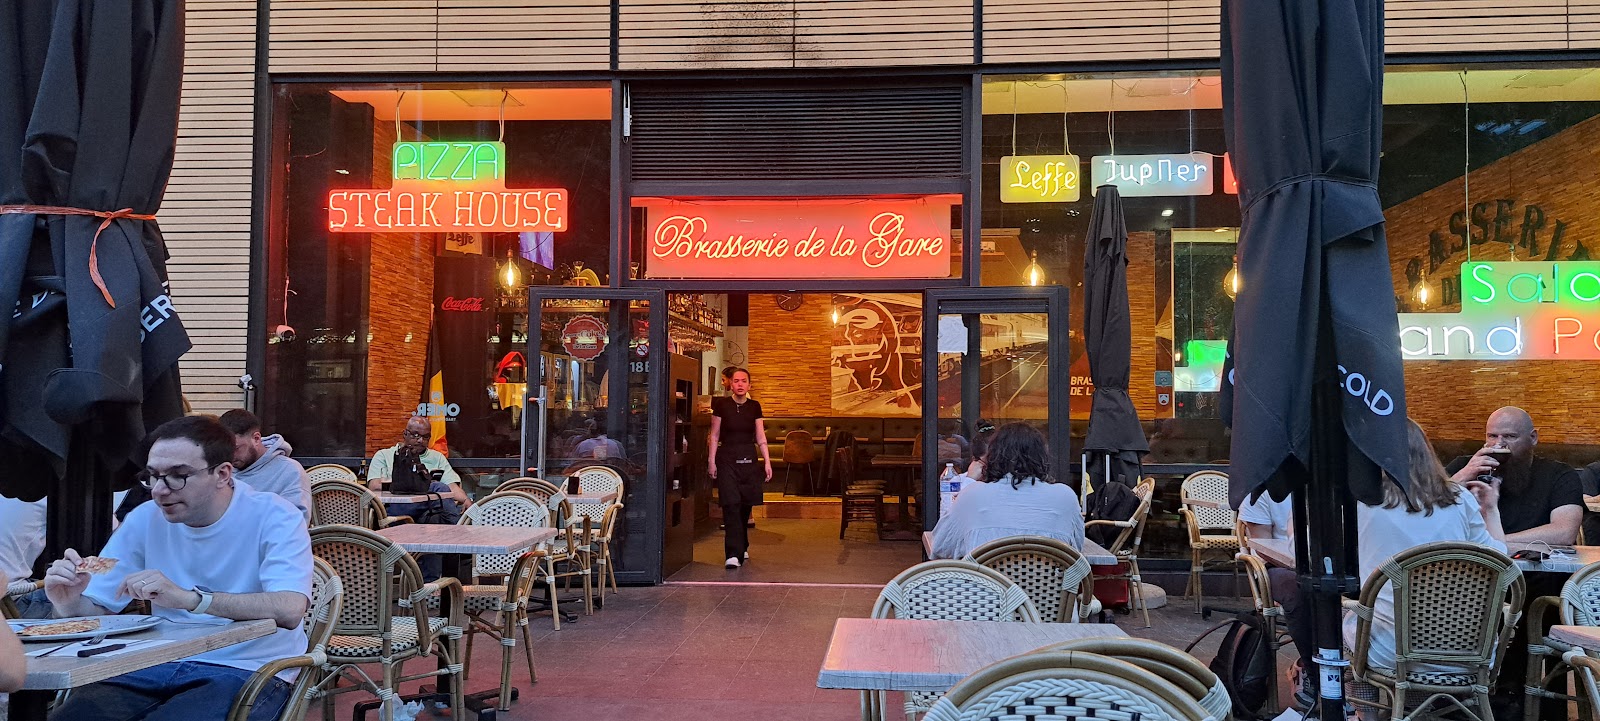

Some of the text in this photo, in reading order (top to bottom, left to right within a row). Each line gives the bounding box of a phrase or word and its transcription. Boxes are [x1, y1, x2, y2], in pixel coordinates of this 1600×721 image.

[394, 143, 499, 181] PIZZA
[1010, 160, 1076, 197] Leffe
[329, 191, 563, 228] STEAK HOUSE
[652, 212, 944, 268] Brasserie de la Gare
[441, 296, 484, 312] Coca-Cola
[1399, 316, 1600, 356] and P
[1070, 386, 1084, 396] DE
